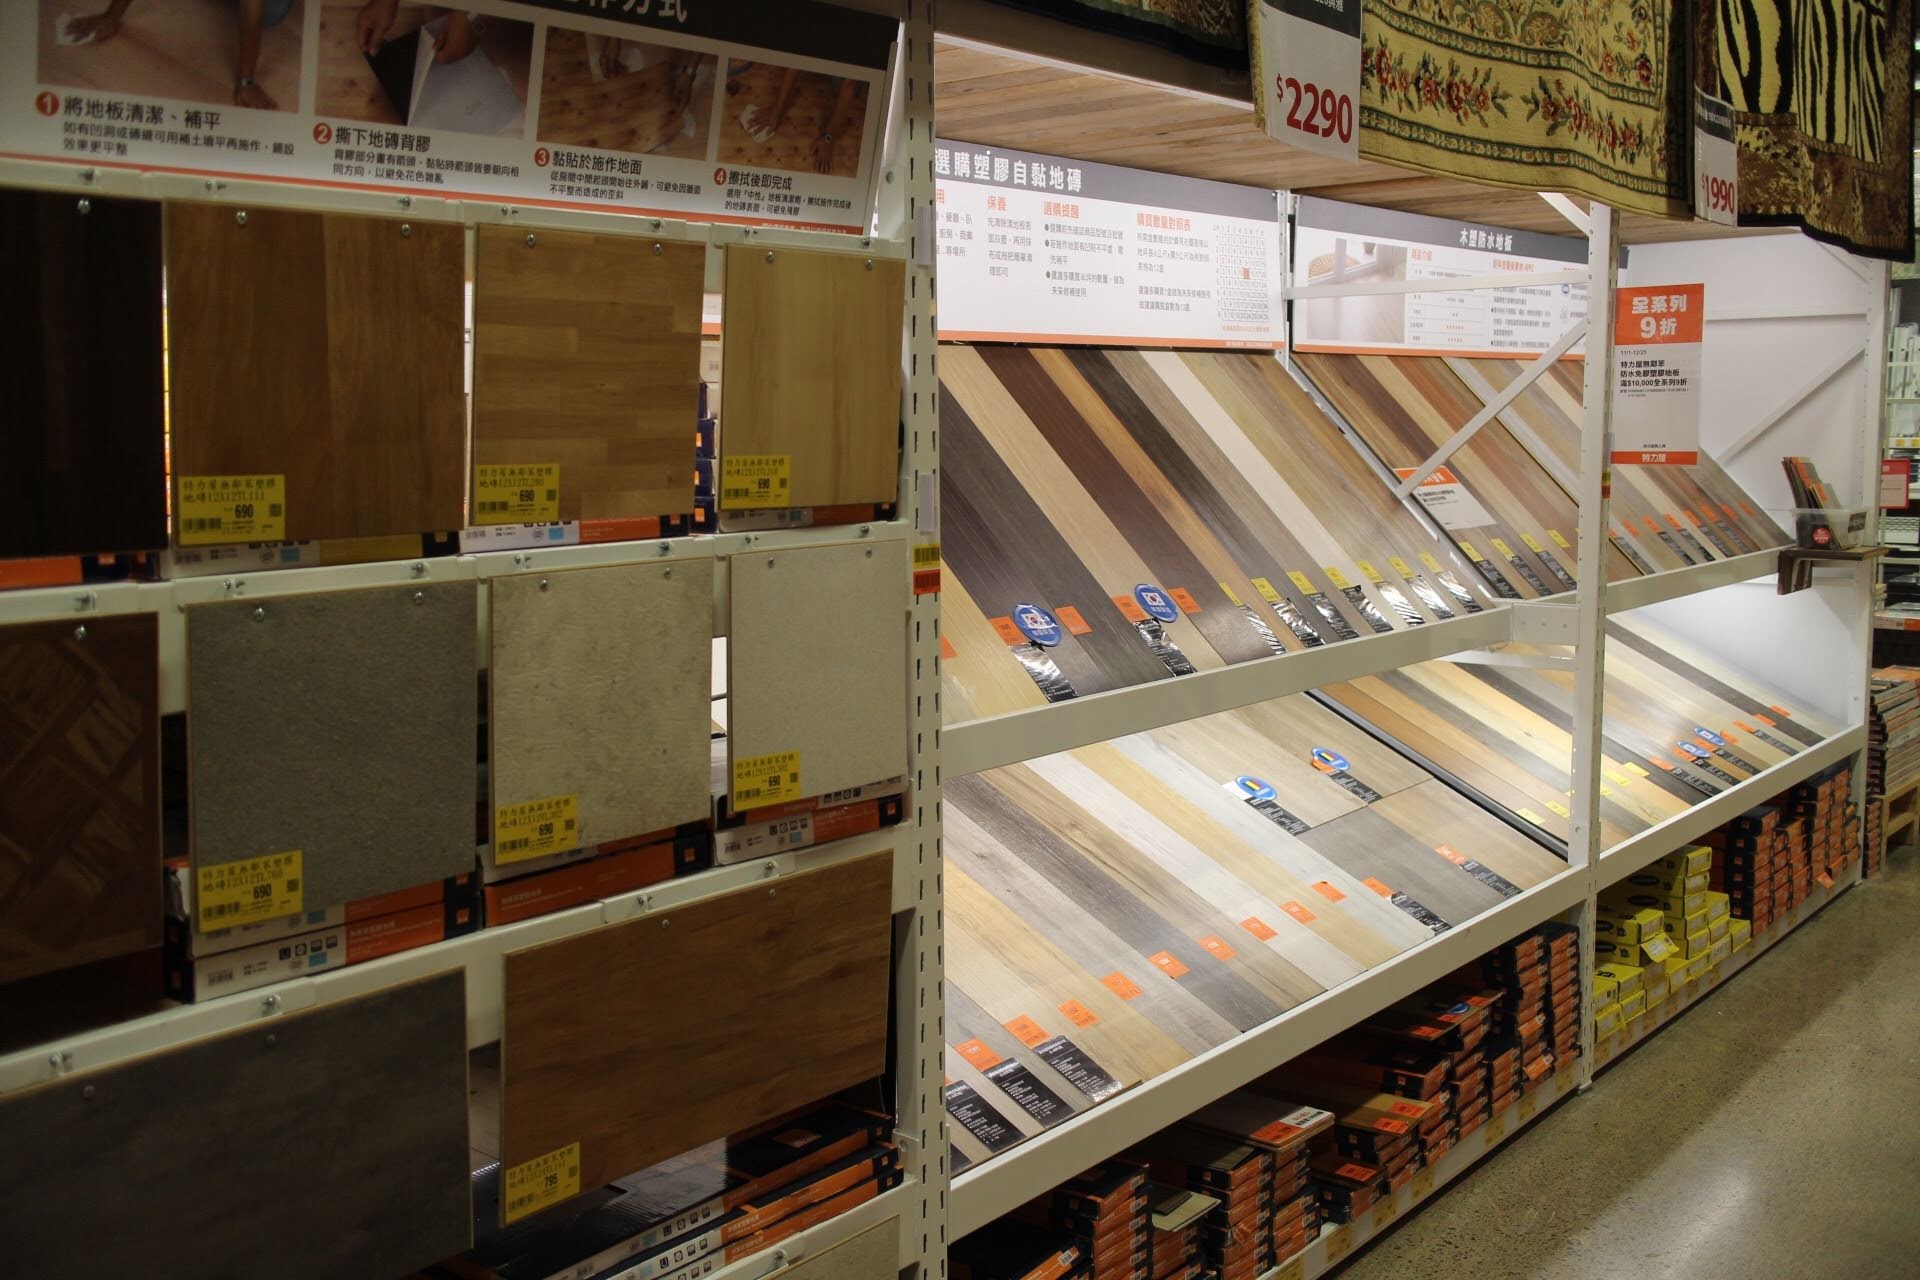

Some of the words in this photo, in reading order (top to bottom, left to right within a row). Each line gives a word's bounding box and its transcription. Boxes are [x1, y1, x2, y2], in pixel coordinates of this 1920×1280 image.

[63, 96, 221, 130] 將地板清潔、補平
[1277, 73, 1353, 144] $2290
[63, 138, 128, 156] 效果更平整
[335, 126, 431, 152] 撕下地磚背膠
[552, 150, 642, 175] 黏貼於施作地面
[728, 169, 793, 190] 擦拭後即完成
[1459, 228, 1513, 252] 木塑防水地板
[1631, 294, 1687, 315] 全系列
[1640, 316, 1678, 339] 9折
[1641, 453, 1667, 463] 特力屋
[519, 489, 535, 502] 690
[235, 504, 254, 518] 690
[768, 775, 781, 787] 690
[539, 822, 554, 836] 690
[253, 884, 272, 899] 690
[544, 1173, 558, 1188] 795
